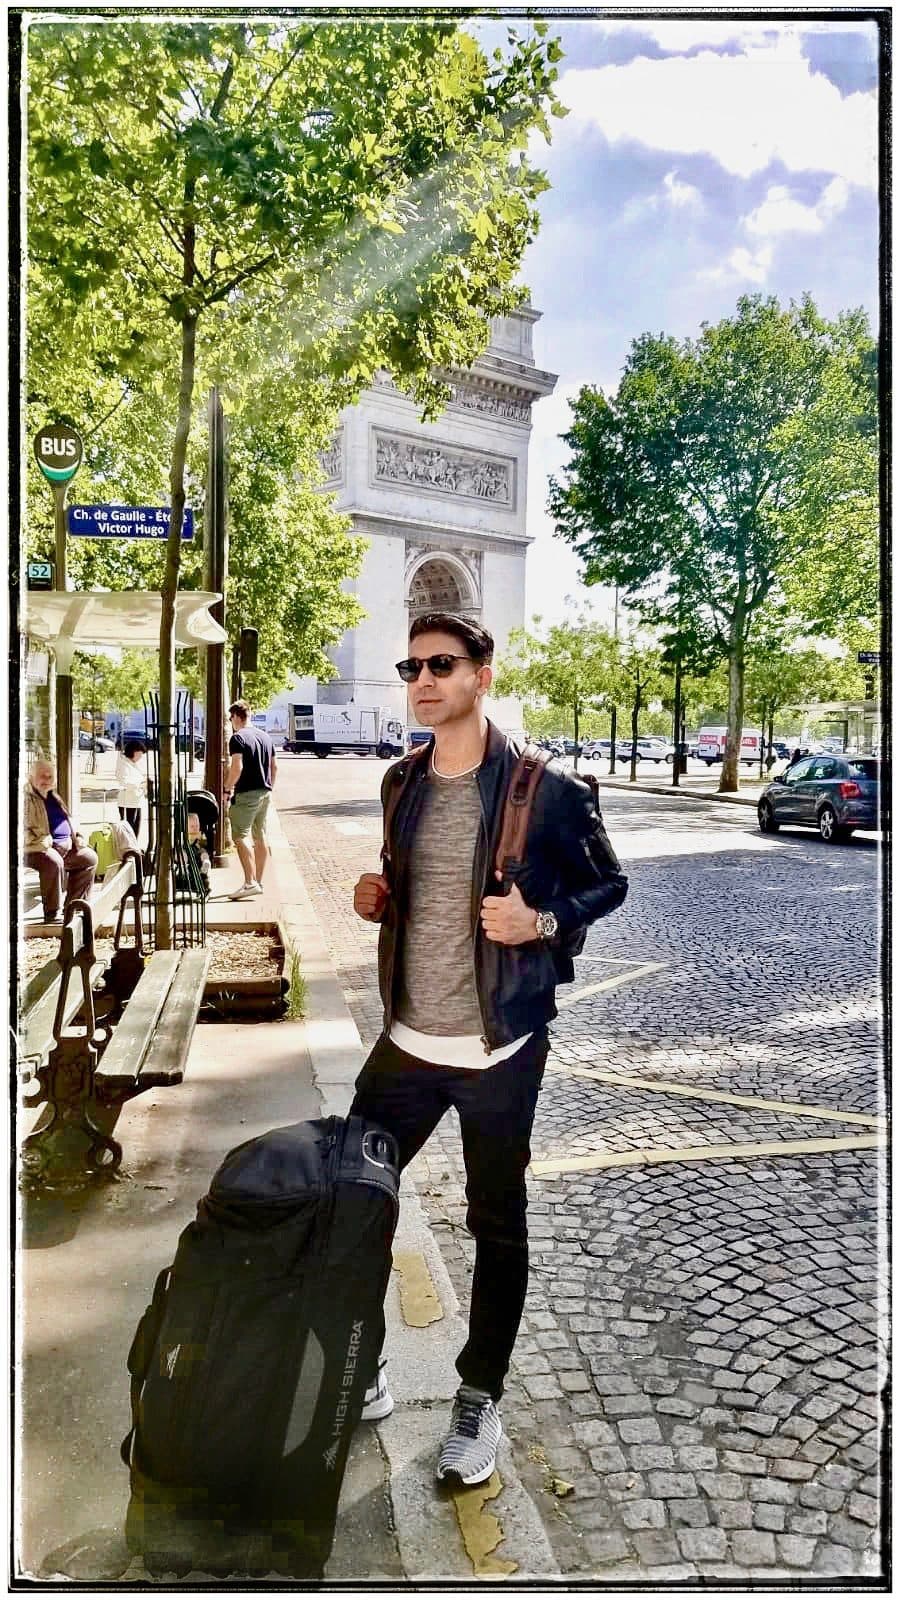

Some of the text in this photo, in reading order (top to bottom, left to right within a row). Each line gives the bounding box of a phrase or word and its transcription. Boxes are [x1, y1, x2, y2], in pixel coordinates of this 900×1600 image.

[41, 437, 76, 456] BUS
[73, 509, 92, 520] Ch.
[94, 509, 108, 520] de
[111, 510, 146, 521] Gaulle
[155, 508, 188, 522] Étoe
[97, 522, 165, 536] Victor Hugo
[31, 565, 49, 576] 52
[332, 1320, 363, 1436] HIGH SIERRA
